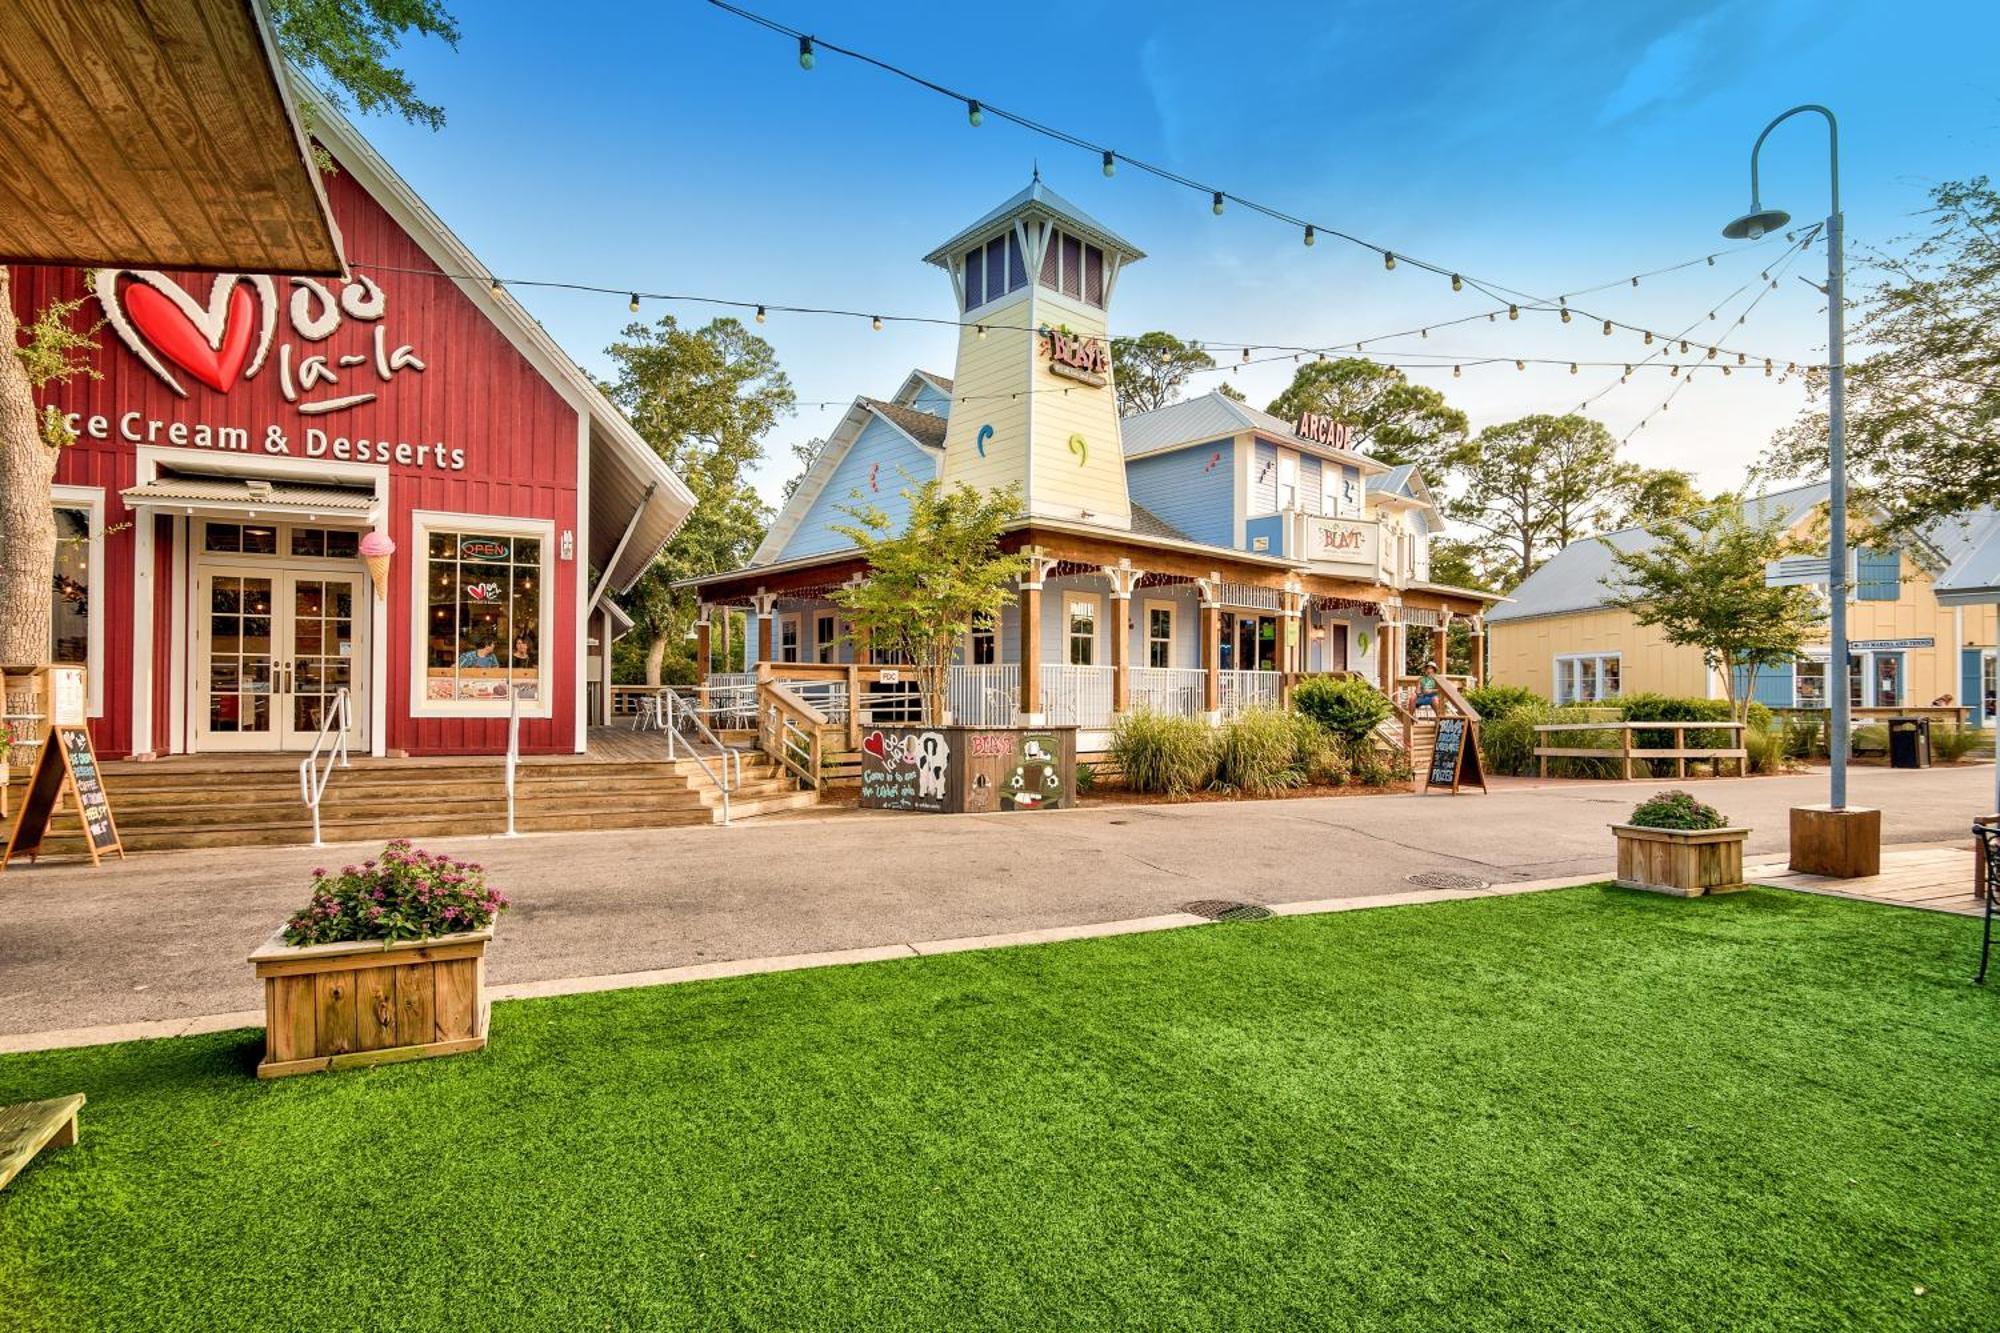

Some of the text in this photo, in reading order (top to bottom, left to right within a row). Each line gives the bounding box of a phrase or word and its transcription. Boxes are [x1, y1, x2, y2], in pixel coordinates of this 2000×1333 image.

[1050, 332, 1105, 373] BLAST
[120, 411, 249, 450] Cream
[264, 425, 290, 454] &
[306, 428, 465, 470] Desserts
[1299, 411, 1355, 451] ARCADE
[463, 544, 504, 556] OPEN
[1323, 528, 1362, 549] BLAST
[971, 733, 1015, 759] BLAST
